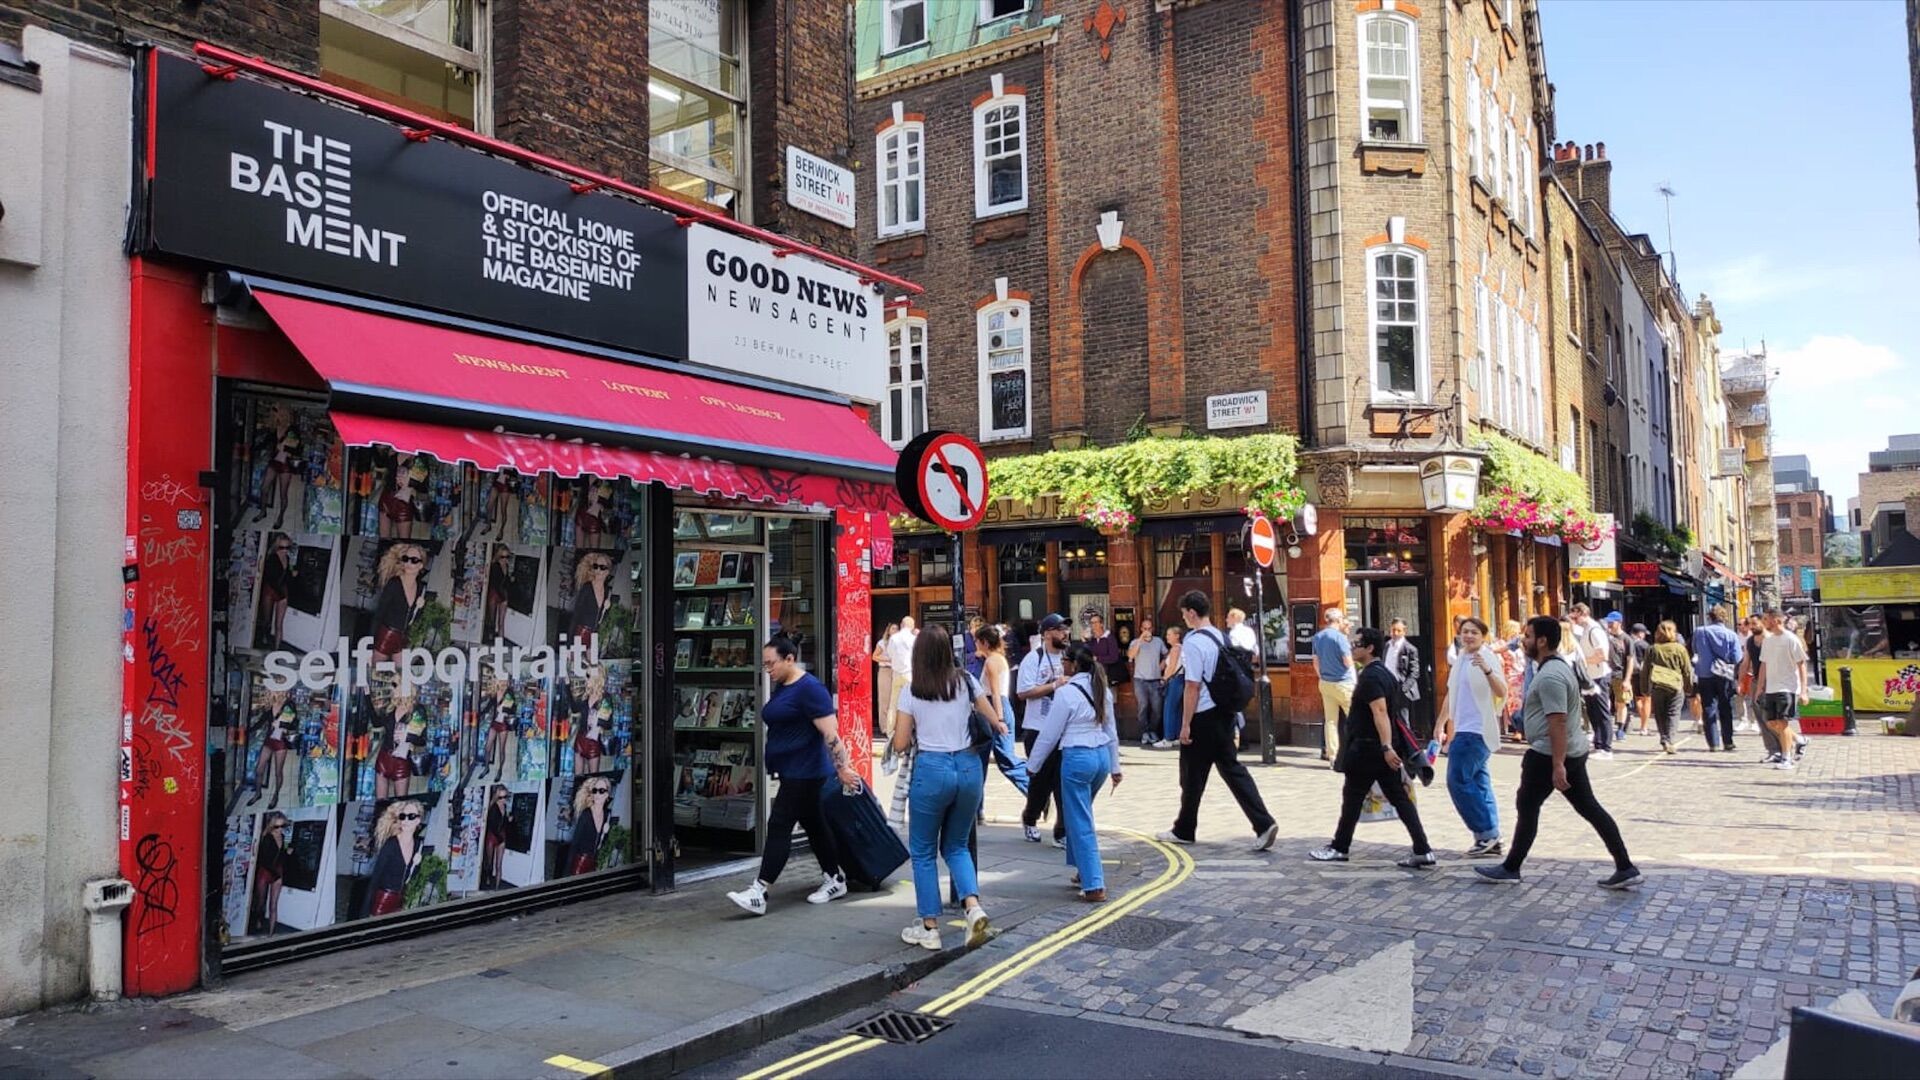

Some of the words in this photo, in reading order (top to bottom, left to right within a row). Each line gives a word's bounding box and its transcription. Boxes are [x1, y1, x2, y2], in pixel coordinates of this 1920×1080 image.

[263, 120, 351, 171] THE
[795, 155, 840, 186] BERWICK
[230, 152, 351, 213] BASE
[795, 173, 832, 200] STREET
[836, 189, 850, 207] W1
[286, 208, 406, 267] MENT
[482, 190, 574, 234] OFFICIAL
[578, 217, 634, 250] HOME
[482, 213, 498, 236] &
[503, 218, 613, 265] STOCKISTS
[616, 250, 641, 271] OF
[482, 234, 525, 264] THE
[530, 247, 635, 291] BASEMENT
[483, 257, 591, 302] MAGAZINE
[706, 249, 790, 295] GOOD
[797, 275, 868, 319] NEWS
[708, 284, 867, 343] NEWSAGENT
[453, 352, 570, 380] NEWSAGENT
[602, 379, 671, 401] LOTTERY
[1211, 394, 1259, 408] BROADWICK
[1212, 407, 1241, 418] STREET
[1243, 405, 1256, 415] W1
